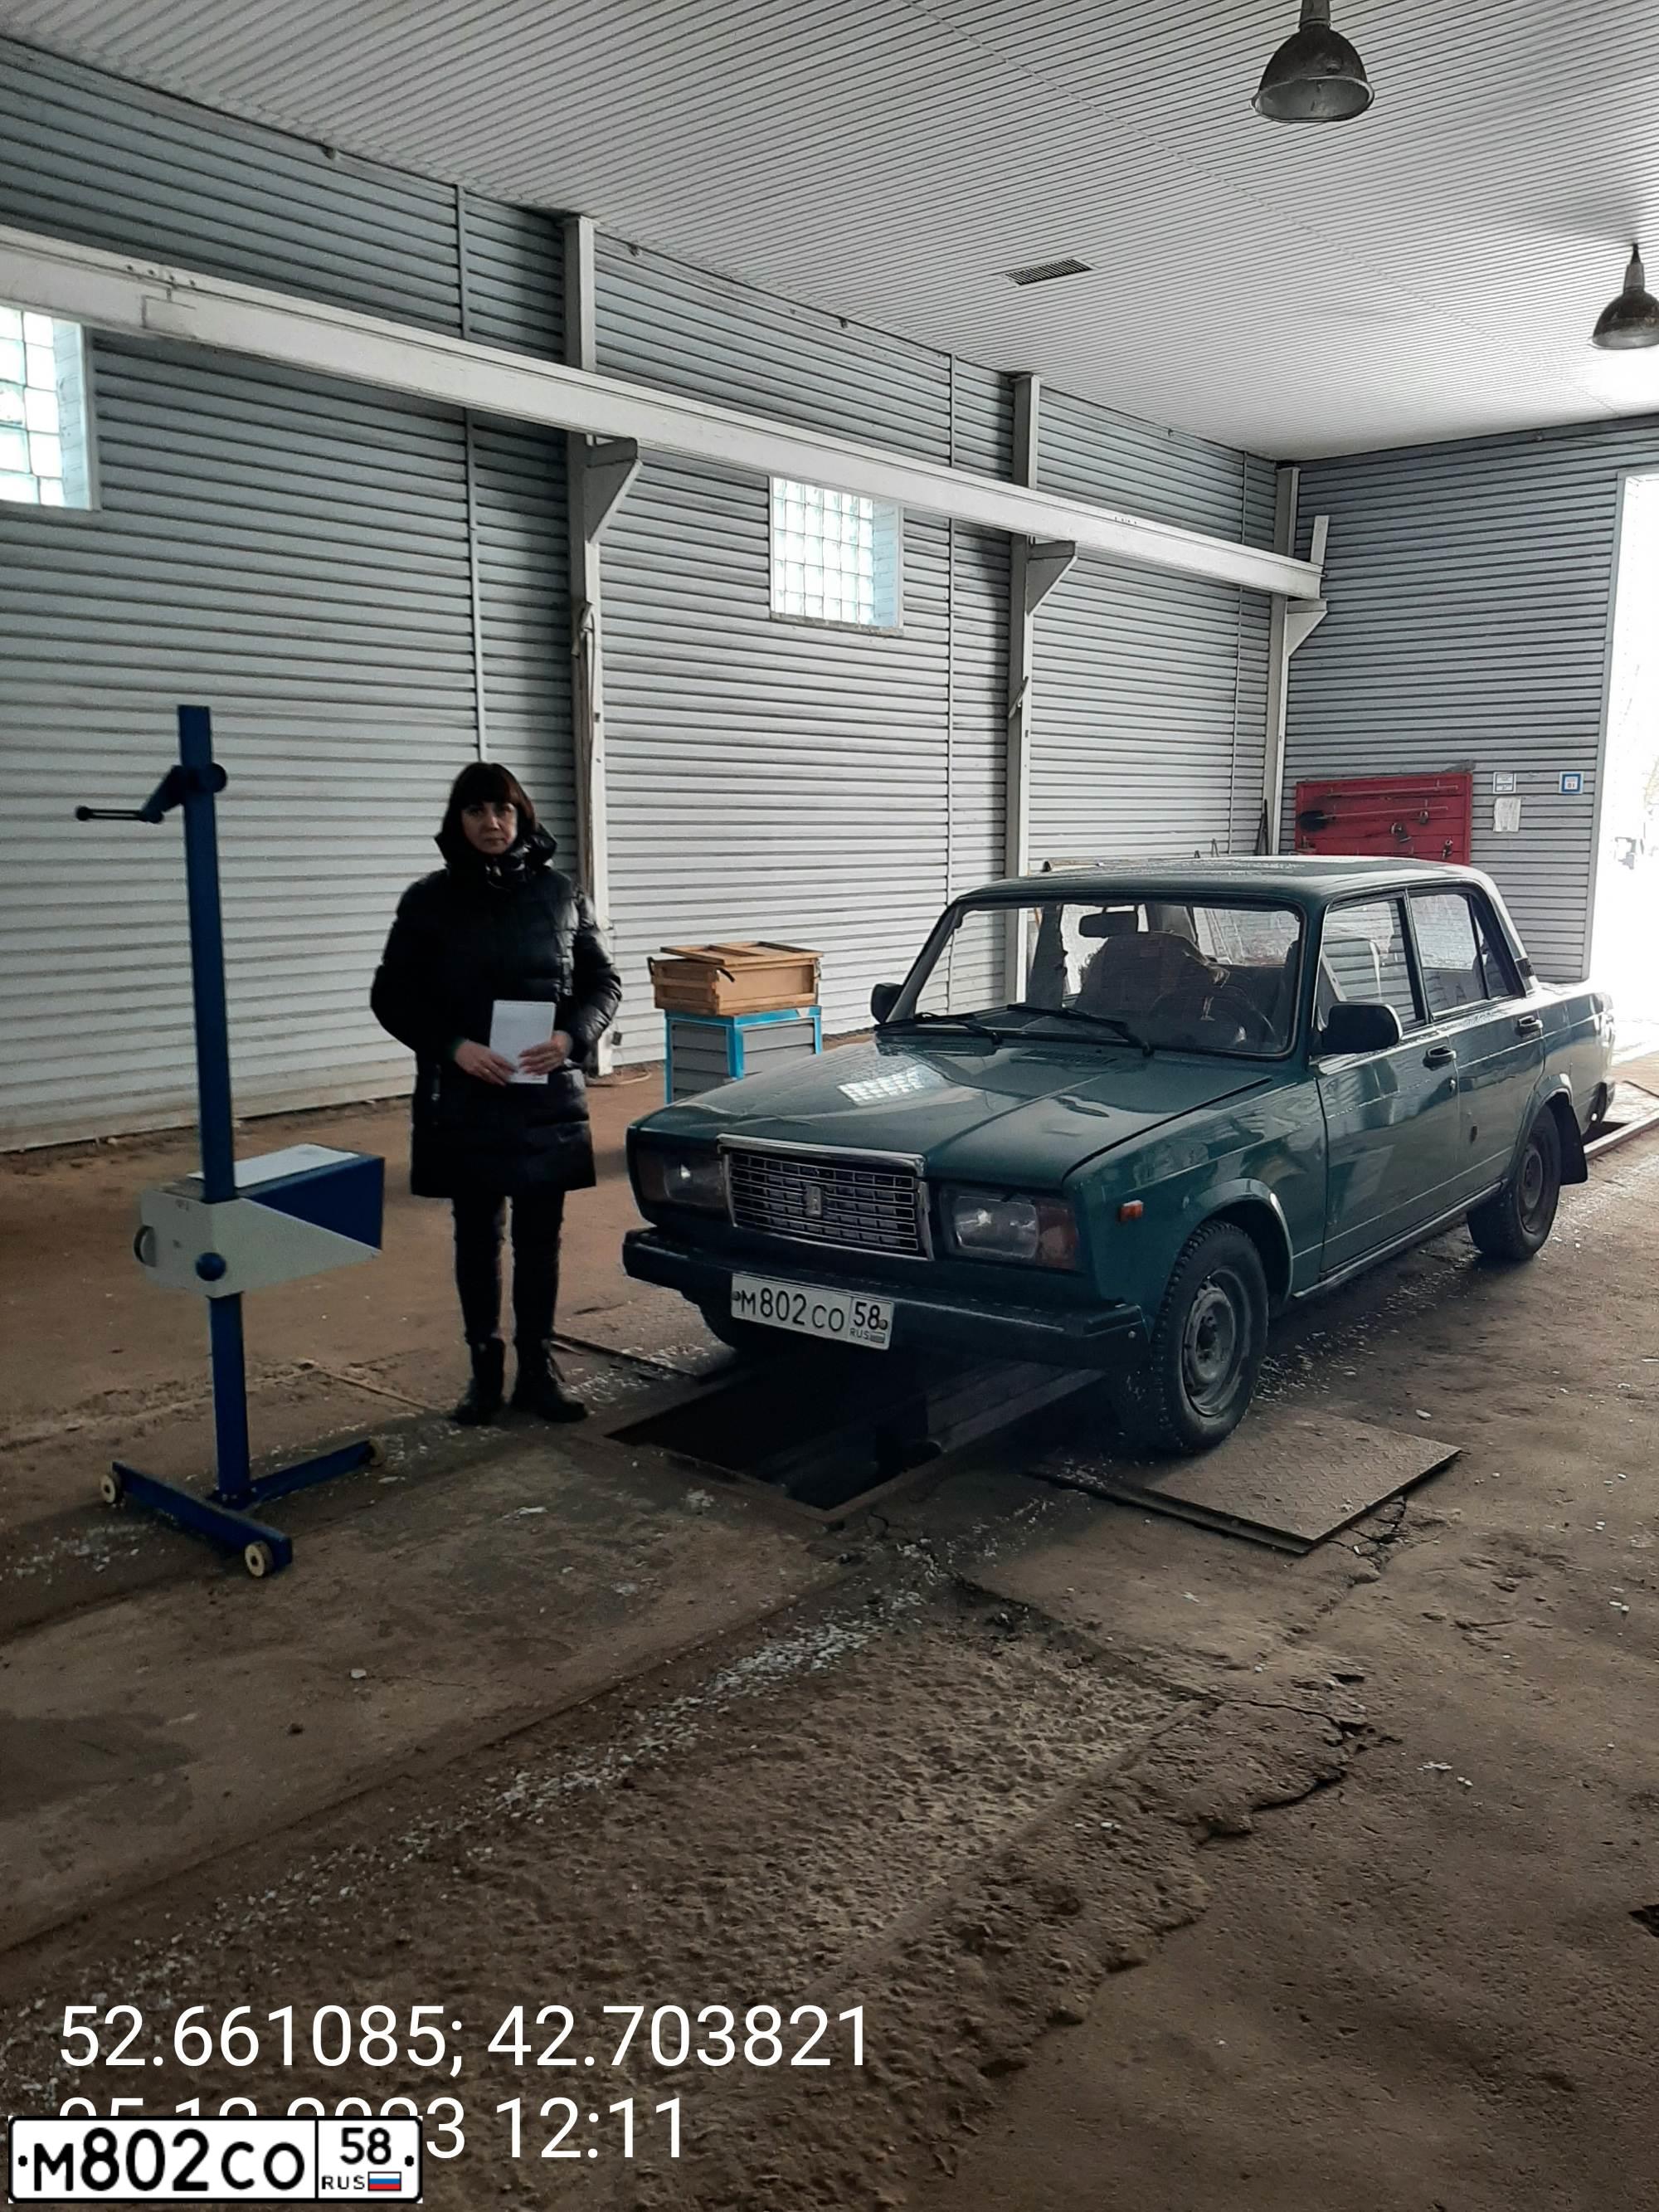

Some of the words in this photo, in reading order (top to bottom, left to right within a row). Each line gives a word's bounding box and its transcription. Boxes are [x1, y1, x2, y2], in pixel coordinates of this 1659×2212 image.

[741, 1287, 844, 1332] M802CO
[853, 1301, 881, 1330] 58
[849, 1328, 869, 1340] RUS
